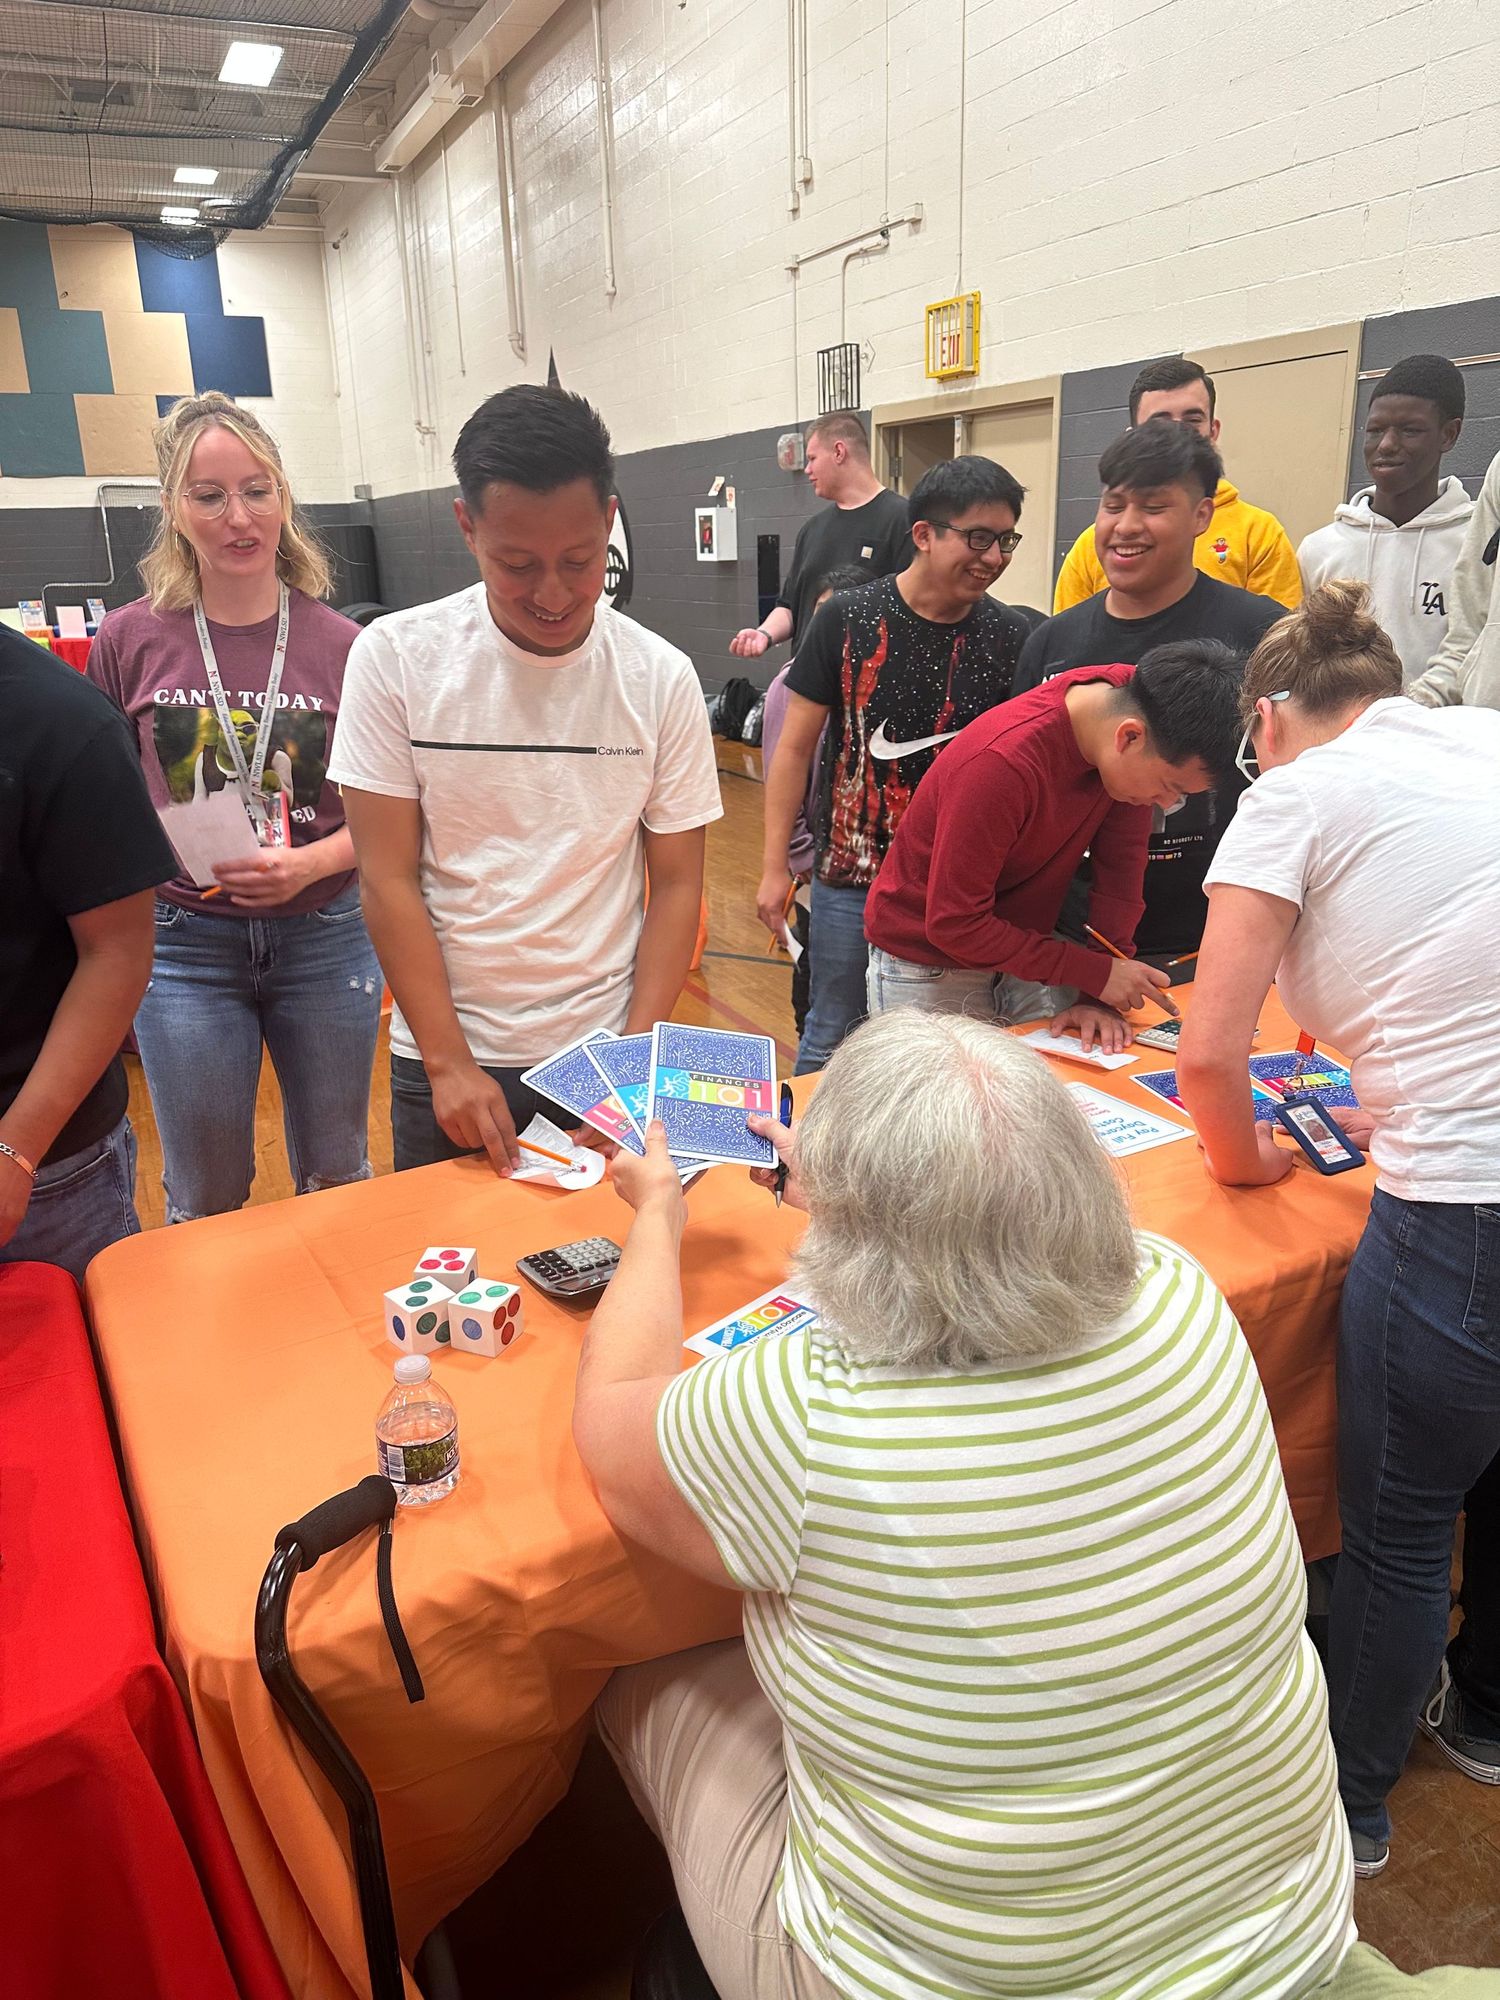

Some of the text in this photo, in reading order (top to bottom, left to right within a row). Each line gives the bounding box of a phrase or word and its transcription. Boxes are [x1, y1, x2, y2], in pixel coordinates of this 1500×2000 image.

[279, 618, 288, 642] NWLSD
[212, 681, 224, 707] NWLSD
[238, 690, 323, 711] TODAY
[598, 746, 644, 756] Calvin Klein
[253, 751, 264, 778] NWLSD
[692, 1074, 761, 1089] FINANCES
[697, 1082, 762, 1108] 101
[1096, 1121, 1147, 1136] Daycare
[1111, 1127, 1160, 1144] Pay Full
[749, 1299, 797, 1327] 101
